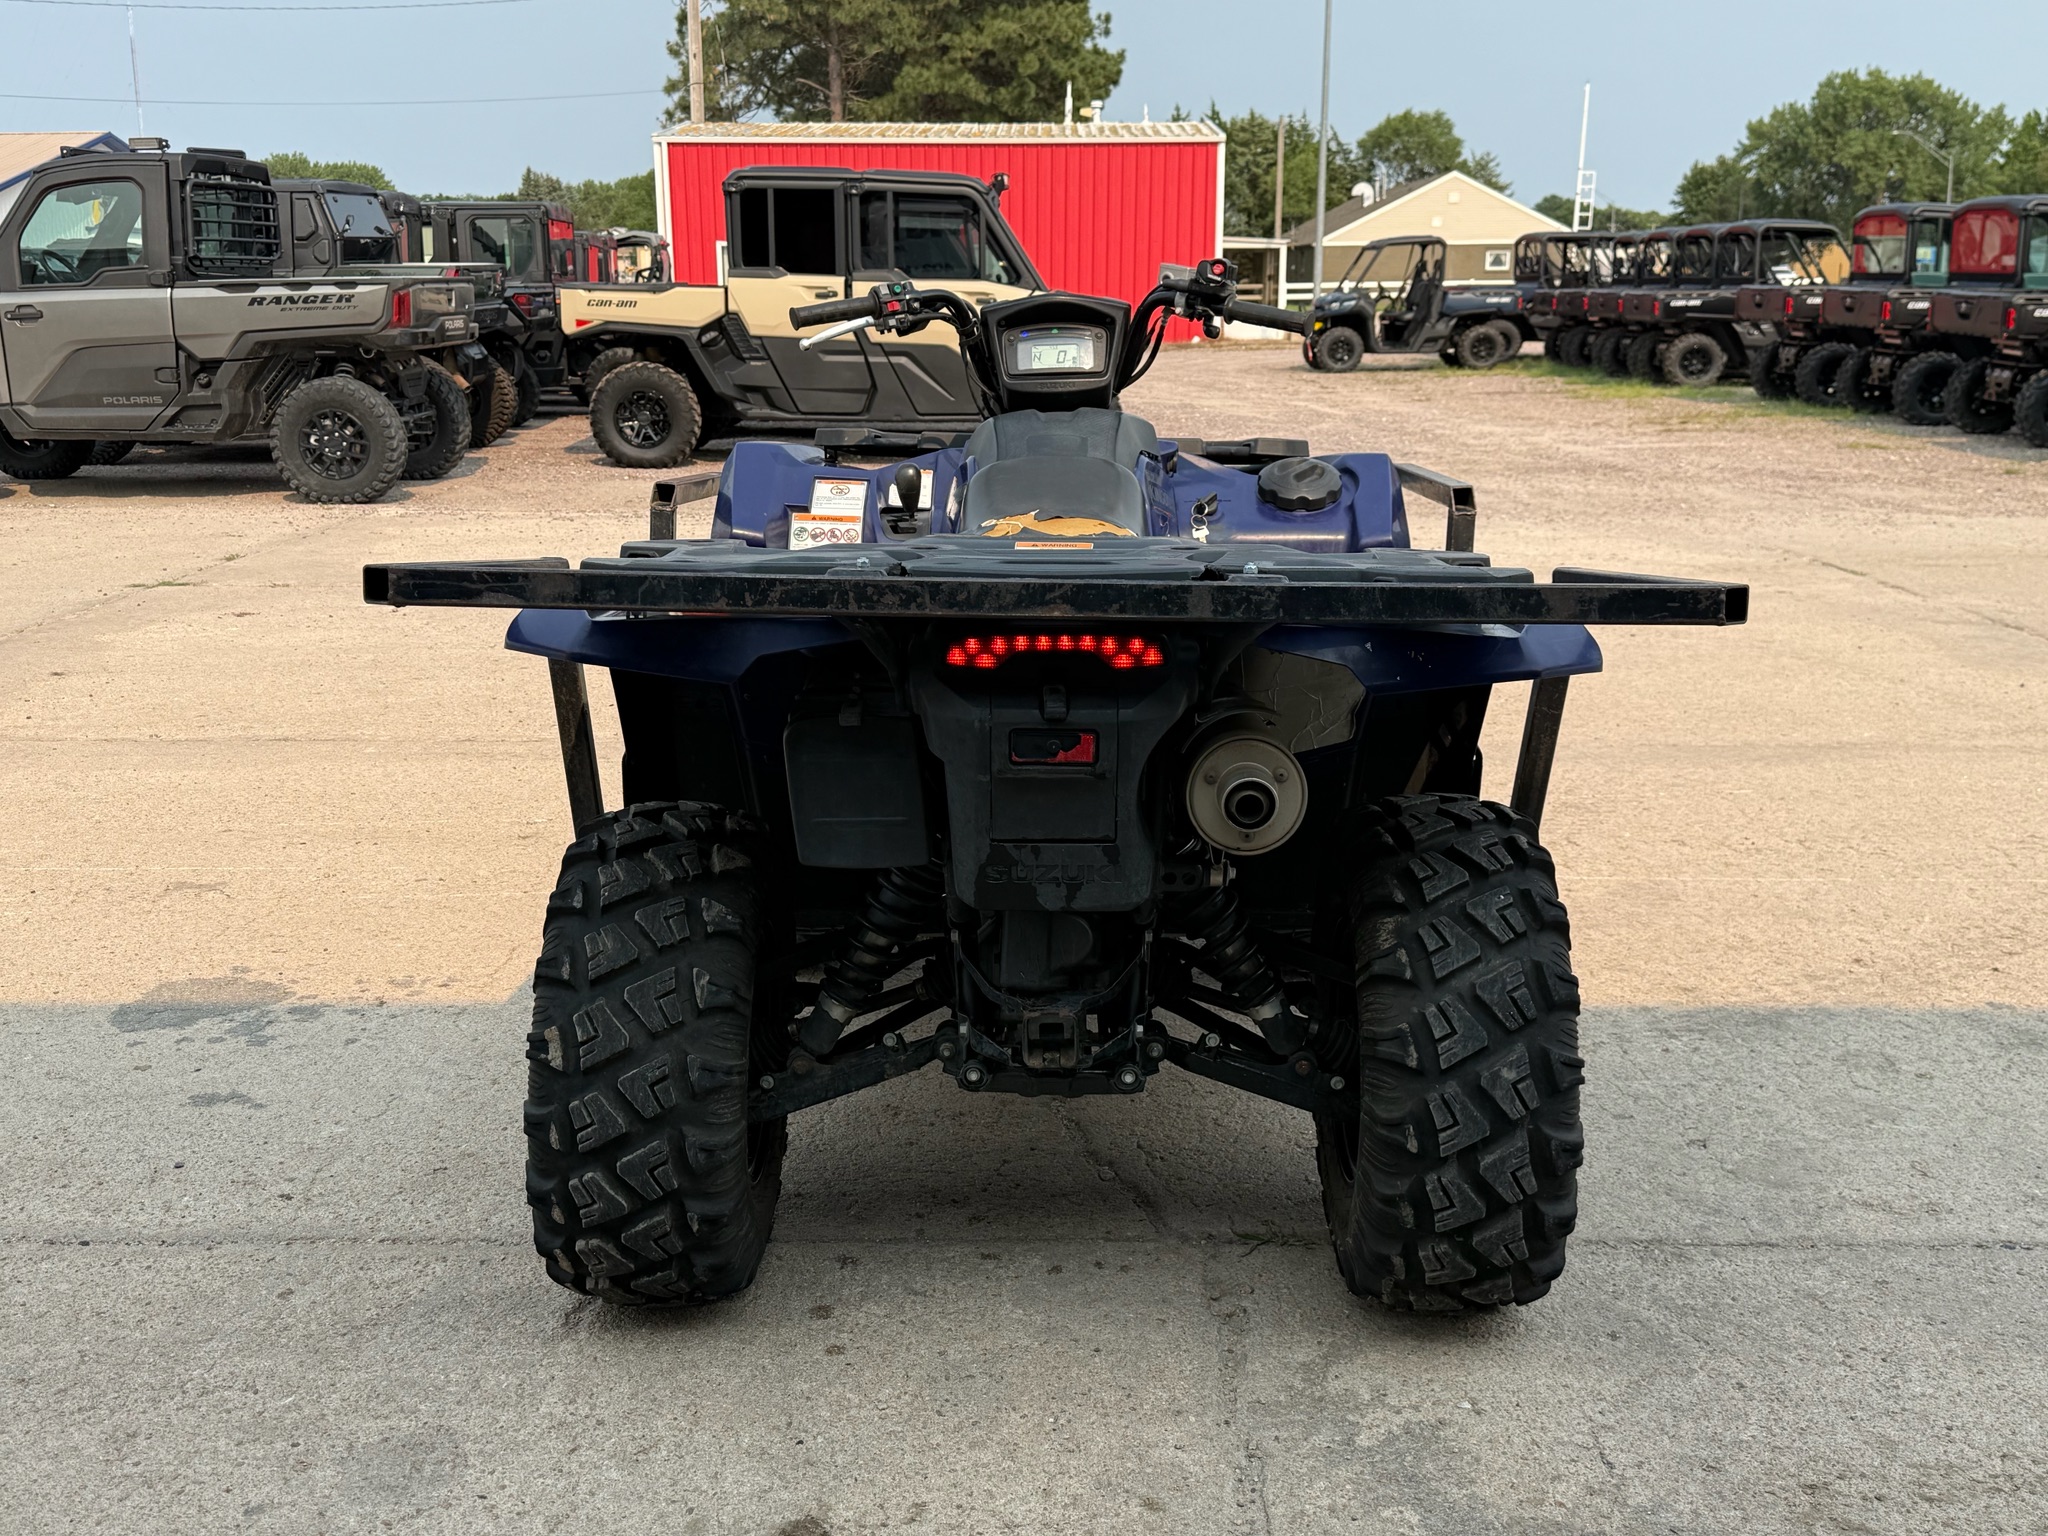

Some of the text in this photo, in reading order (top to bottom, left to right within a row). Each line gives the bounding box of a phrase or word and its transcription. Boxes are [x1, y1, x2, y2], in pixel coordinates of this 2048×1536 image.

[247, 294, 355, 306] RANGER
[587, 299, 638, 308] can-am
[1033, 353, 1042, 362] N
[1056, 350, 1067, 364] 0
[103, 396, 163, 404] POLARIS
[983, 864, 1123, 884] SUZUKI
